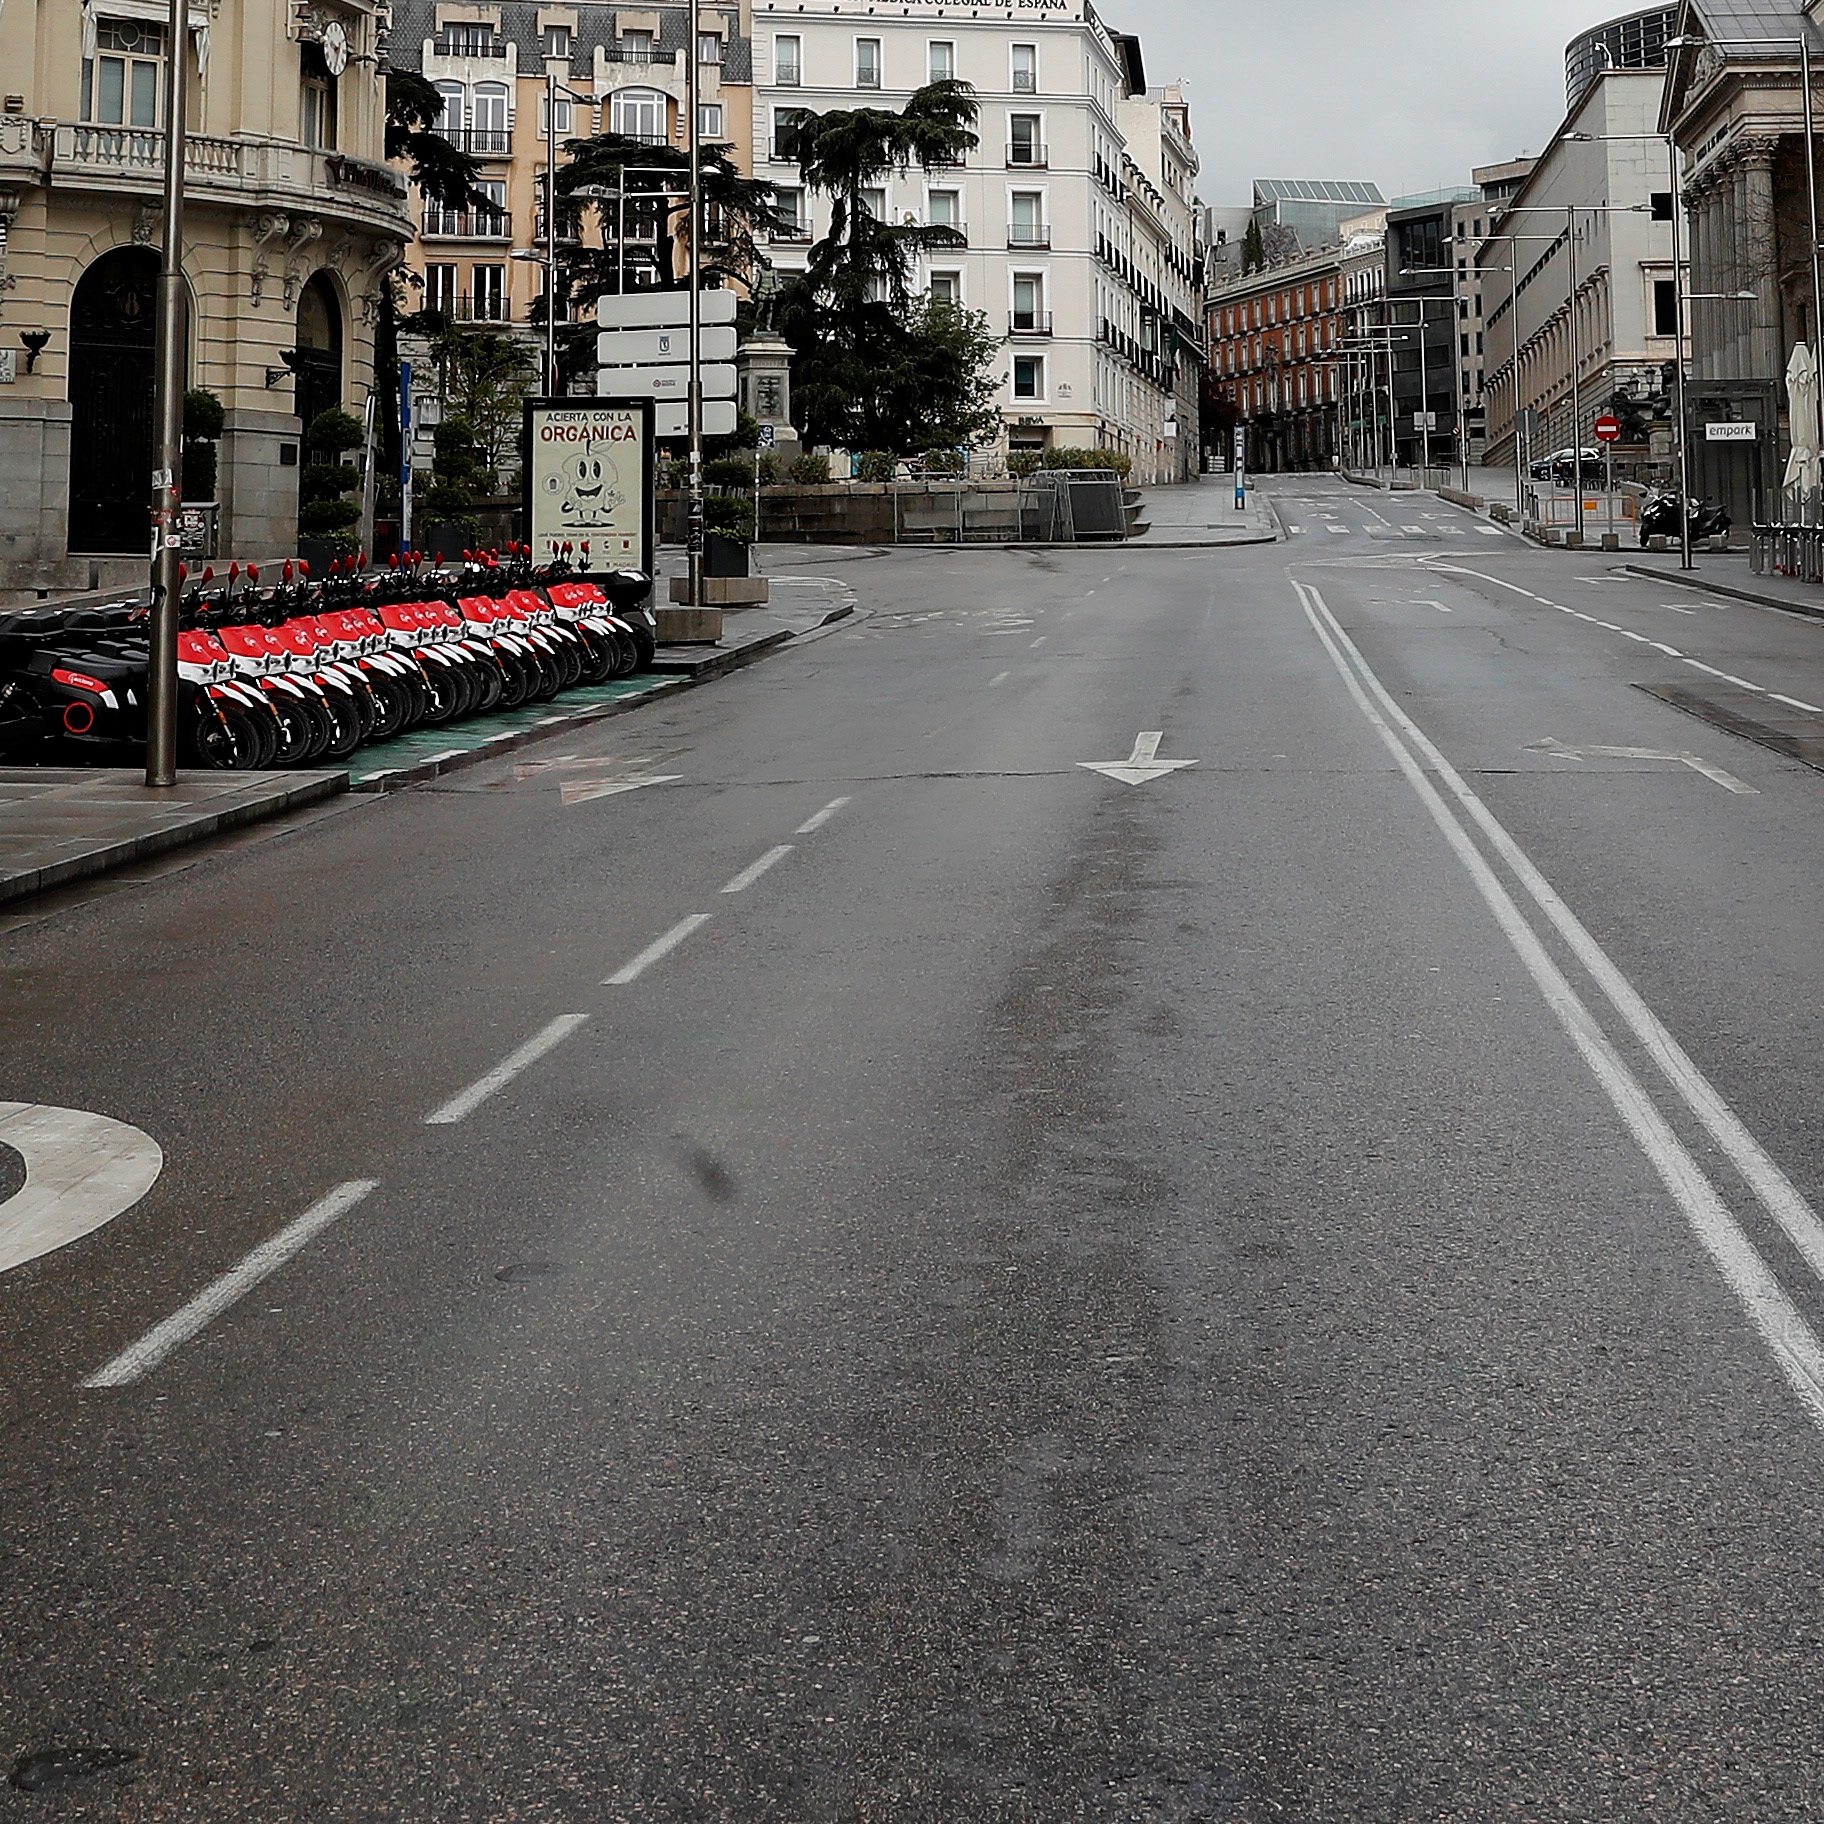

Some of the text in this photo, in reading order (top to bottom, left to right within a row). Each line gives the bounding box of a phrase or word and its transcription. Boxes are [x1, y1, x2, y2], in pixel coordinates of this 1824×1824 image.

[546, 412, 632, 422] ACIERTA CON LA
[1018, 416, 1044, 425] BBVA
[540, 422, 637, 442] ORGÁNICA
[1709, 425, 1752, 439] empark
